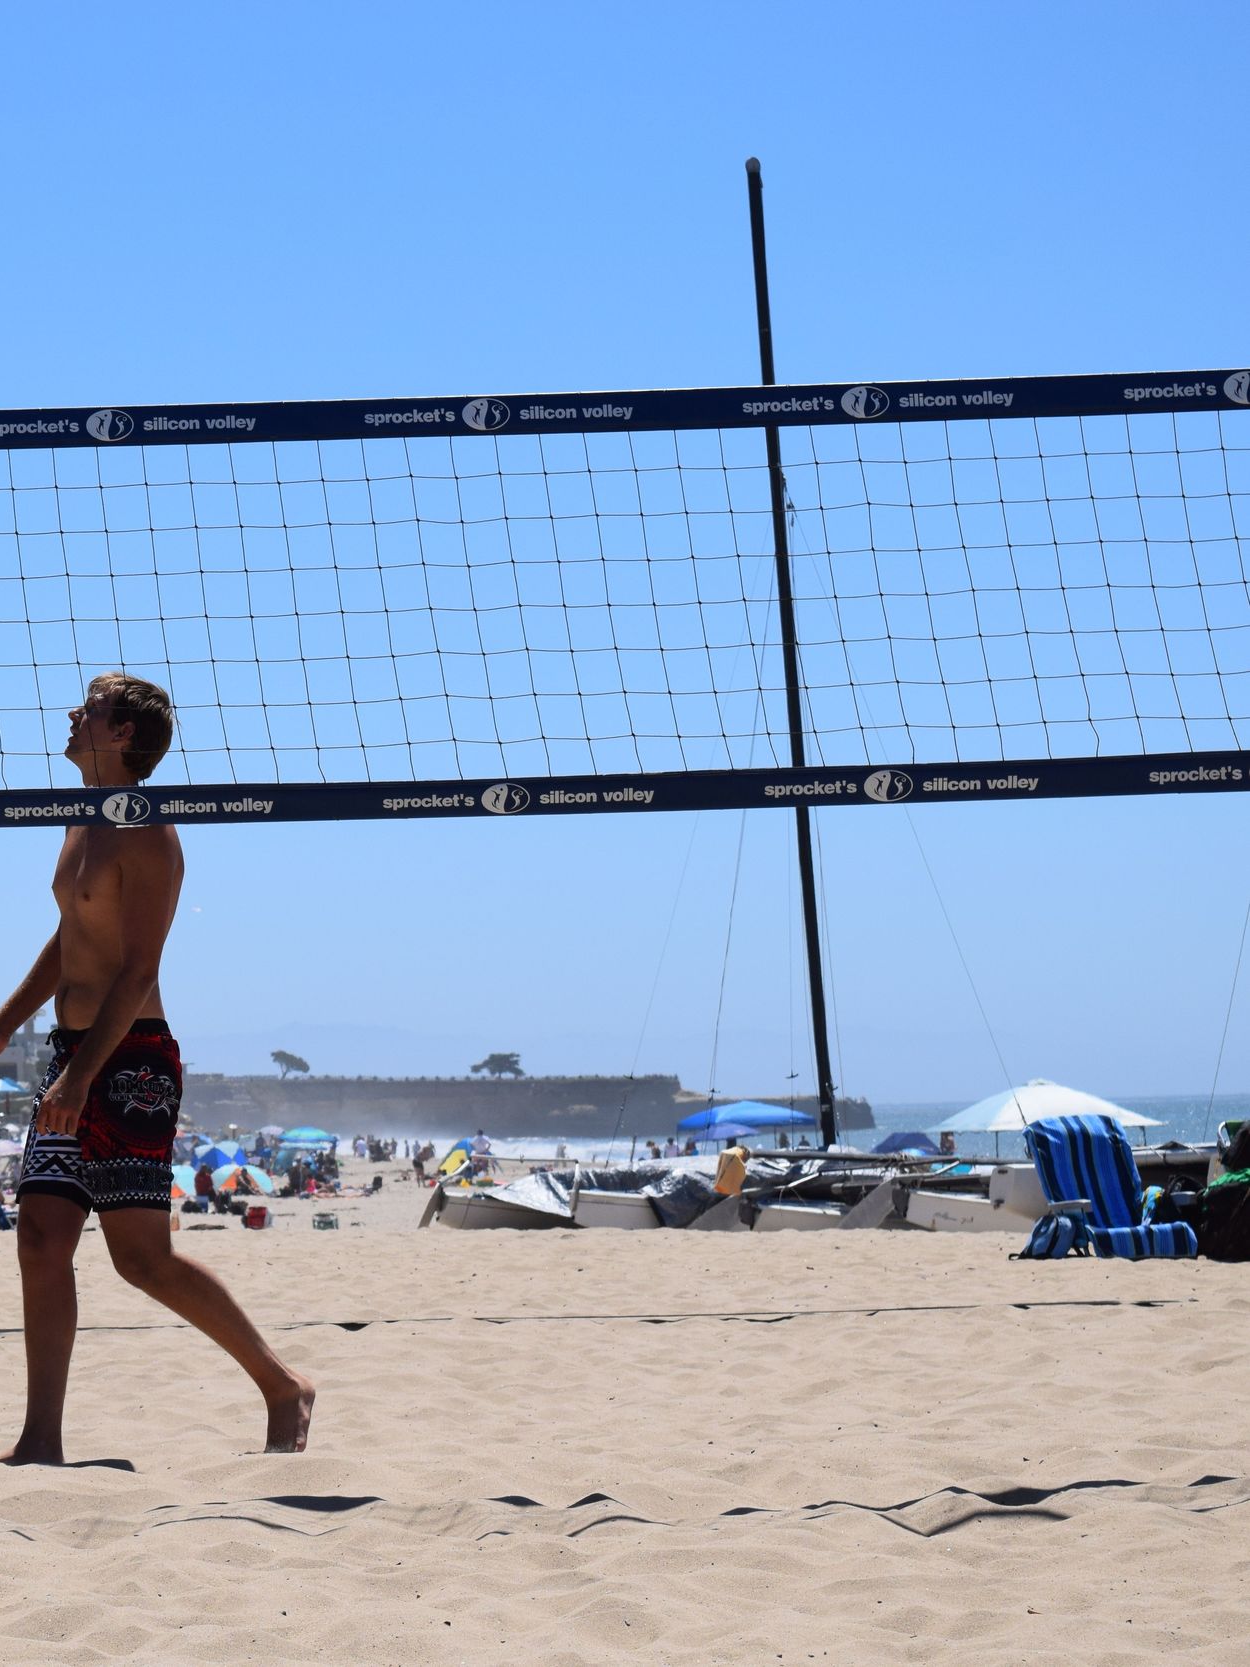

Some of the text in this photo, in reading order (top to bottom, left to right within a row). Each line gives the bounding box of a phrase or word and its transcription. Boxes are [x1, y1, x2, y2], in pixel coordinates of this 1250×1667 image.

[742, 390, 1014, 416] sprocket's silicon volley
[1124, 382, 1217, 402] sprocket's
[143, 416, 200, 431] silicon
[205, 415, 256, 431] volley
[364, 404, 633, 427] sprocket's silicon volley
[1149, 765, 1243, 785] sprocket's
[764, 775, 1039, 799] sprocket's silicon volley
[4, 797, 274, 820] sprocket's silicon volley
[382, 787, 655, 811] sprocket's silicon volley
